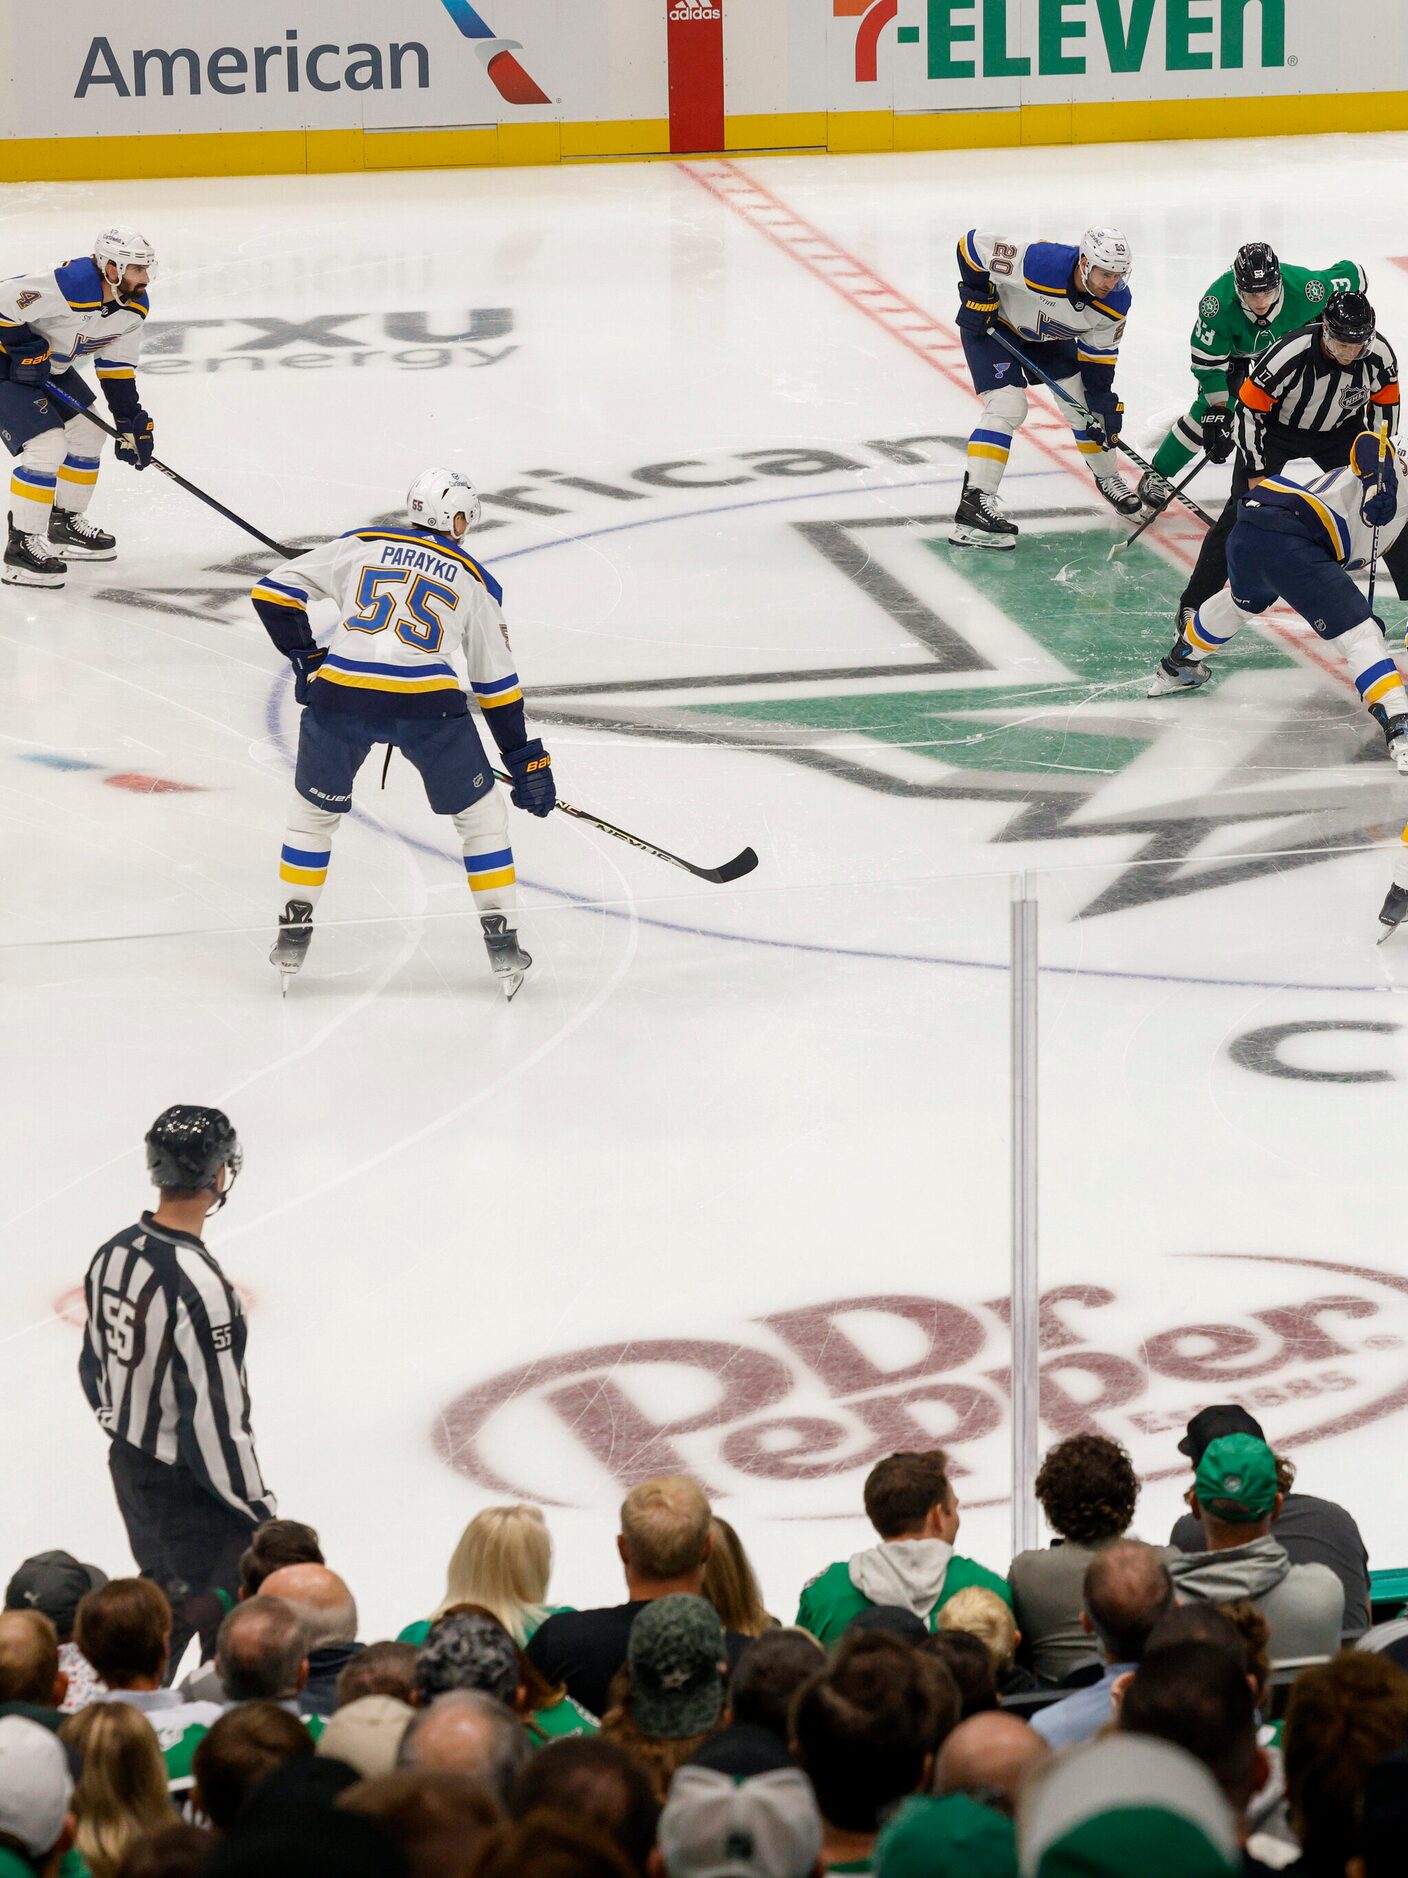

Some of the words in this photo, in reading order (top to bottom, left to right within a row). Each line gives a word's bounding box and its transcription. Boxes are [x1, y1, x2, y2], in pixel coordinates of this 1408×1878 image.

[669, 7, 721, 21] adidas
[73, 29, 430, 98] American
[989, 241, 1018, 277] 20
[16, 289, 43, 310] 4
[136, 344, 520, 375] energy
[412, 499, 424, 512] 55
[380, 545, 458, 583] PARAYKO
[343, 565, 460, 653] 55
[102, 1292, 137, 1362] 55
[749, 1283, 1116, 1399] Dr
[540, 1294, 1381, 1500] Pepper
